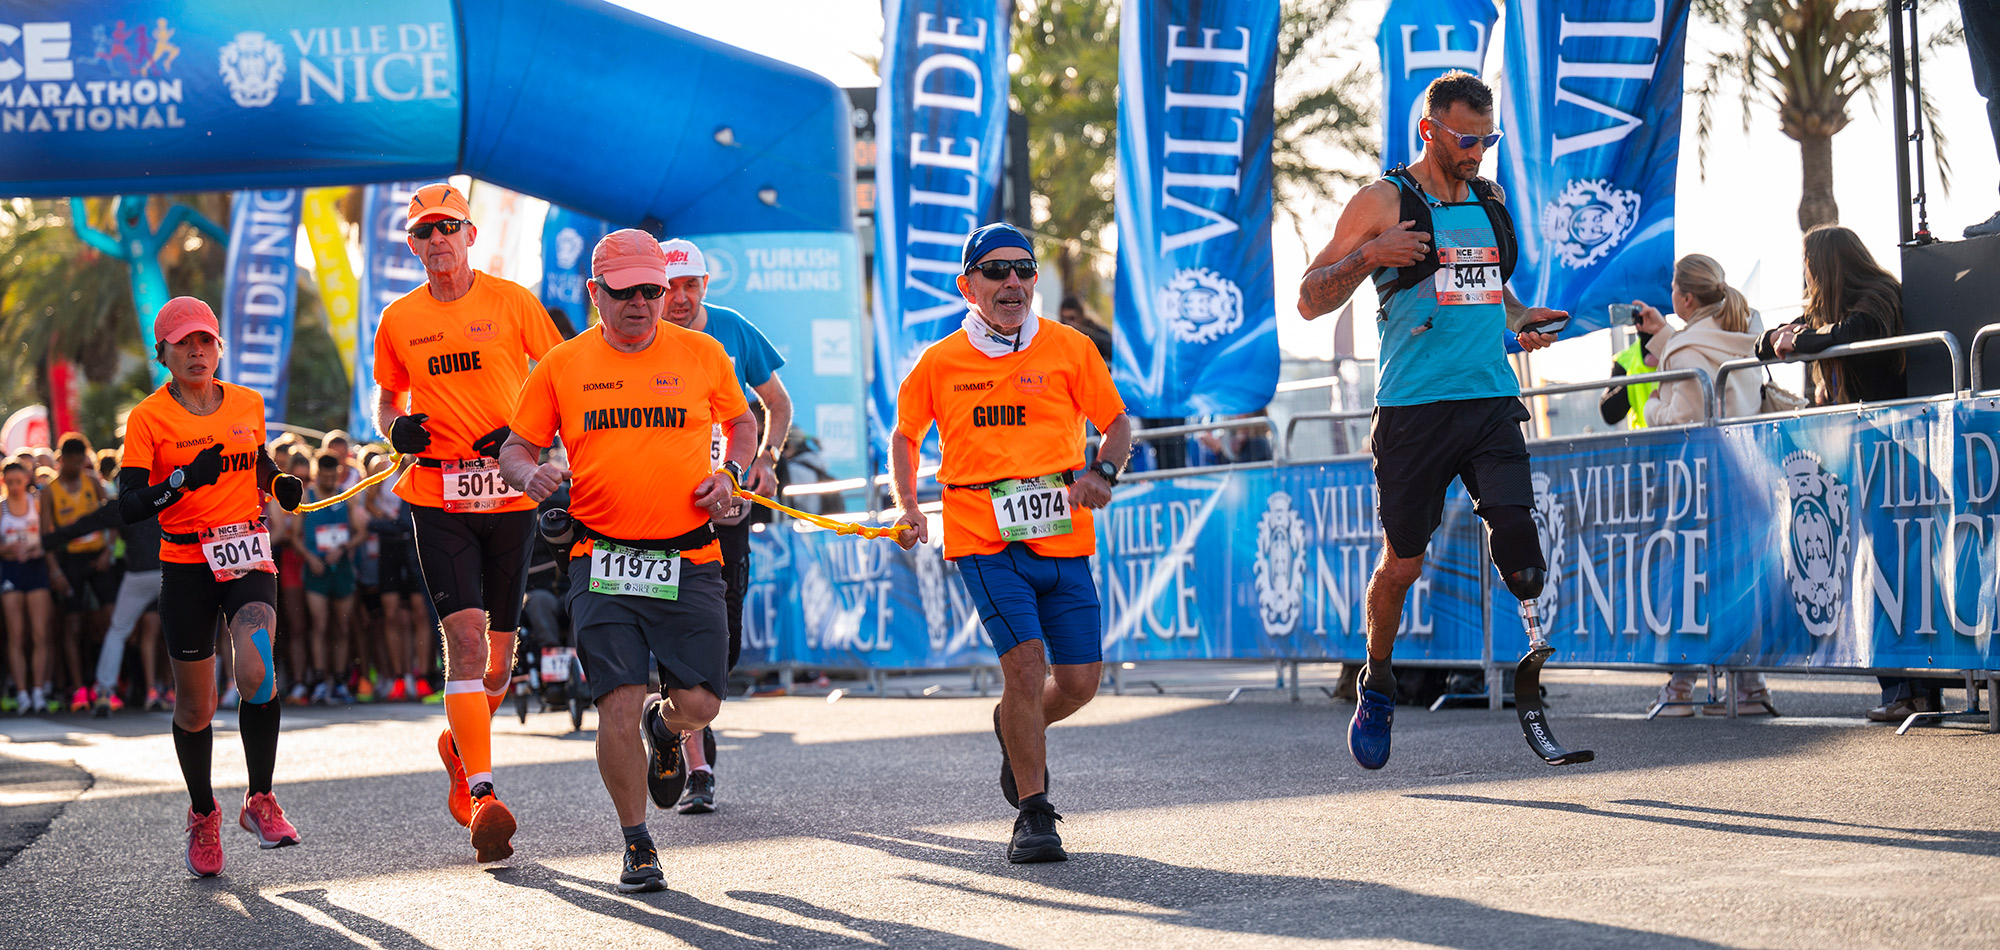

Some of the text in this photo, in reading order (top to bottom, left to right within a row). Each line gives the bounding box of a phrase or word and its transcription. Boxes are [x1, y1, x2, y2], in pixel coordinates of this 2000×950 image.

[290, 22, 448, 56] VILLE DE
[297, 52, 450, 105] NICE
[912, 10, 987, 118] DE
[2, 104, 185, 133] NATIONAL
[1160, 25, 1251, 259] VILLE
[745, 250, 840, 269] TURKISH
[243, 261, 289, 318] DE
[745, 271, 842, 292] AIRLINES
[1454, 264, 1486, 289] 544
[428, 350, 482, 376] GUIDE
[584, 406, 687, 432] MALVOYANT
[973, 405, 1026, 427] GUIDE
[1002, 490, 1065, 523] 11974
[1569, 457, 1708, 527] VILLE DE
[218, 525, 238, 535] NICE
[1102, 499, 1201, 558] VILLE DE
[213, 537, 264, 567] 5014
[600, 553, 672, 582] 11973
[1106, 553, 1200, 640] NICE
[1574, 528, 1709, 636] NICE
